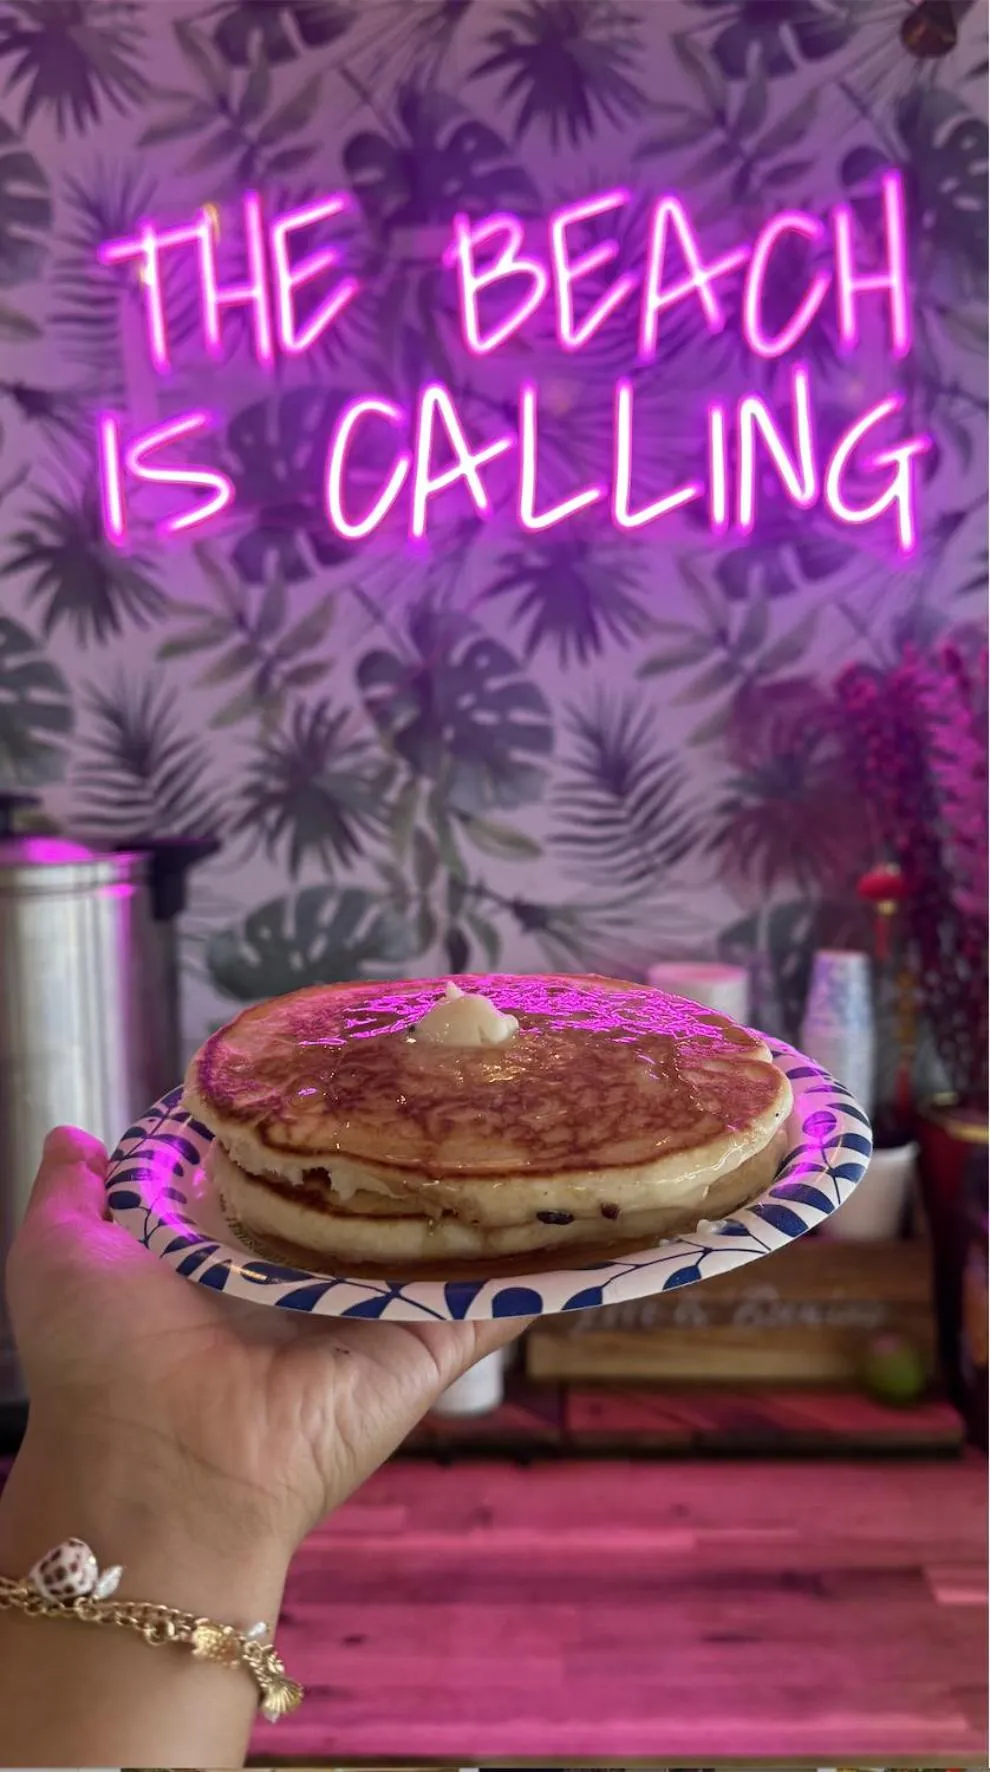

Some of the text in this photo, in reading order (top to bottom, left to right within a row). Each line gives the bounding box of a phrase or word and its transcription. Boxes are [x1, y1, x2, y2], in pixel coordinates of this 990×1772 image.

[98, 171, 911, 369] THE BEACH
[99, 367, 929, 552] IS CALLING
